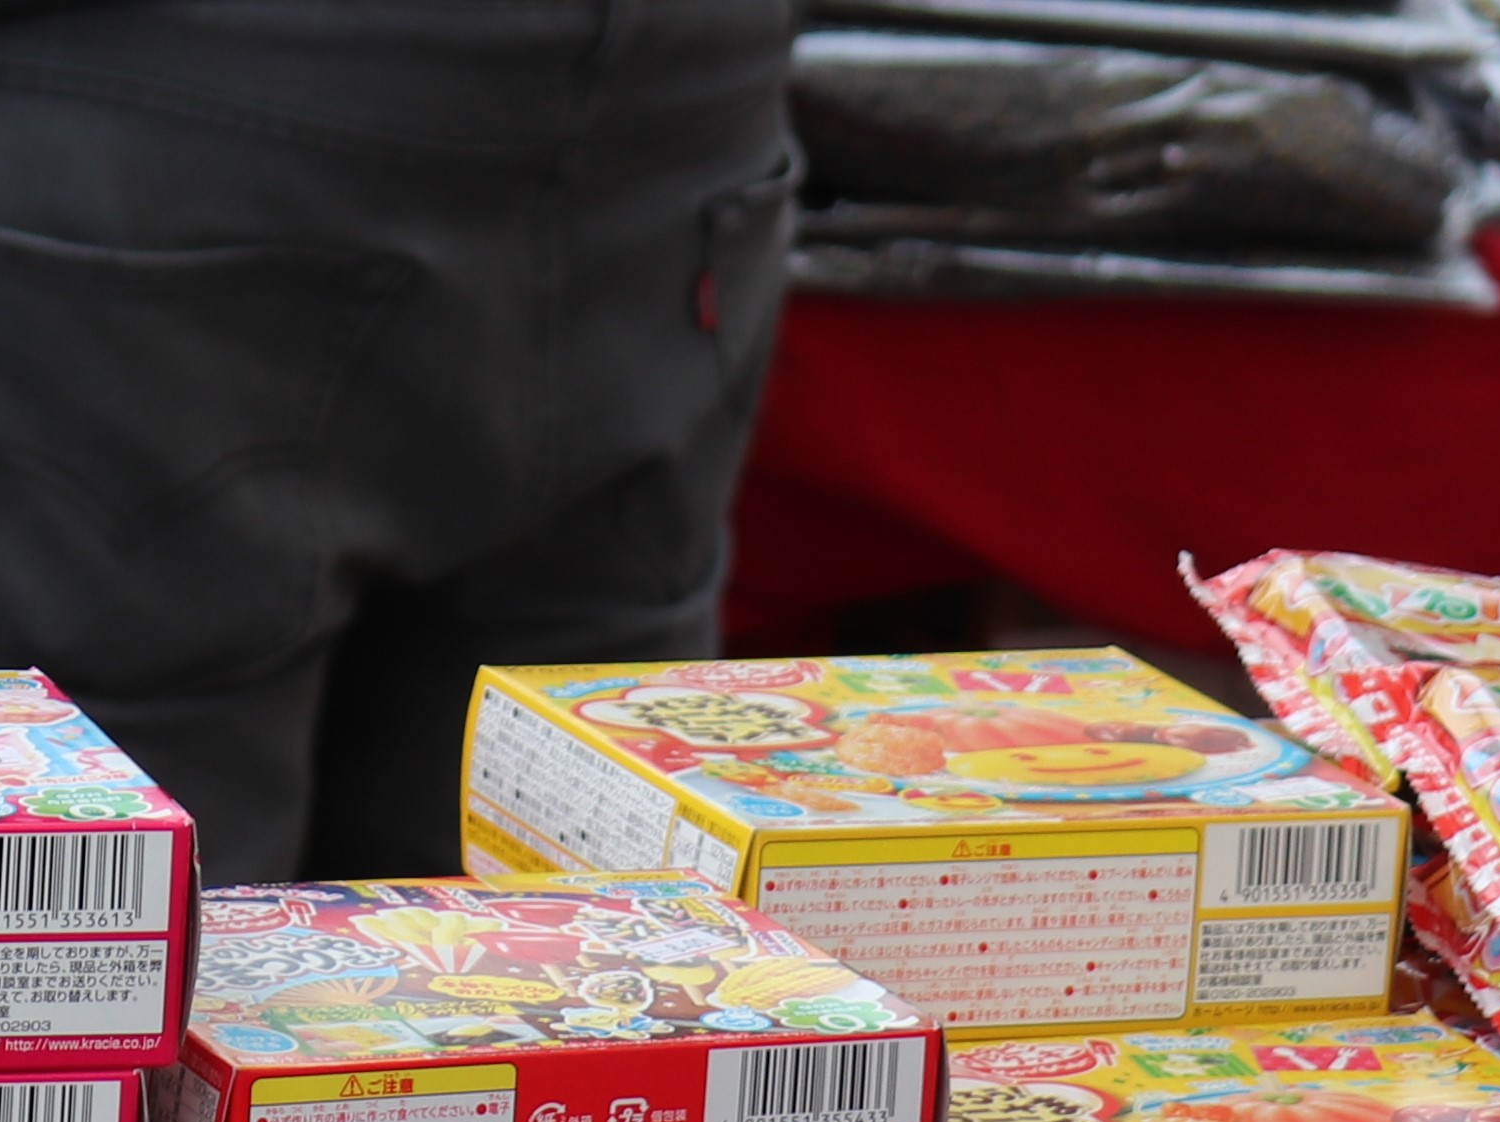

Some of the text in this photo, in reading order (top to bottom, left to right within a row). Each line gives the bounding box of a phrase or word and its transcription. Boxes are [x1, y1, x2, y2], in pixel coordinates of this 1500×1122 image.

[60, 912, 134, 928] 353613
[6, 1036, 161, 1052] http://www.kracie.co.jp/
[367, 1078, 414, 1095] ご注意
